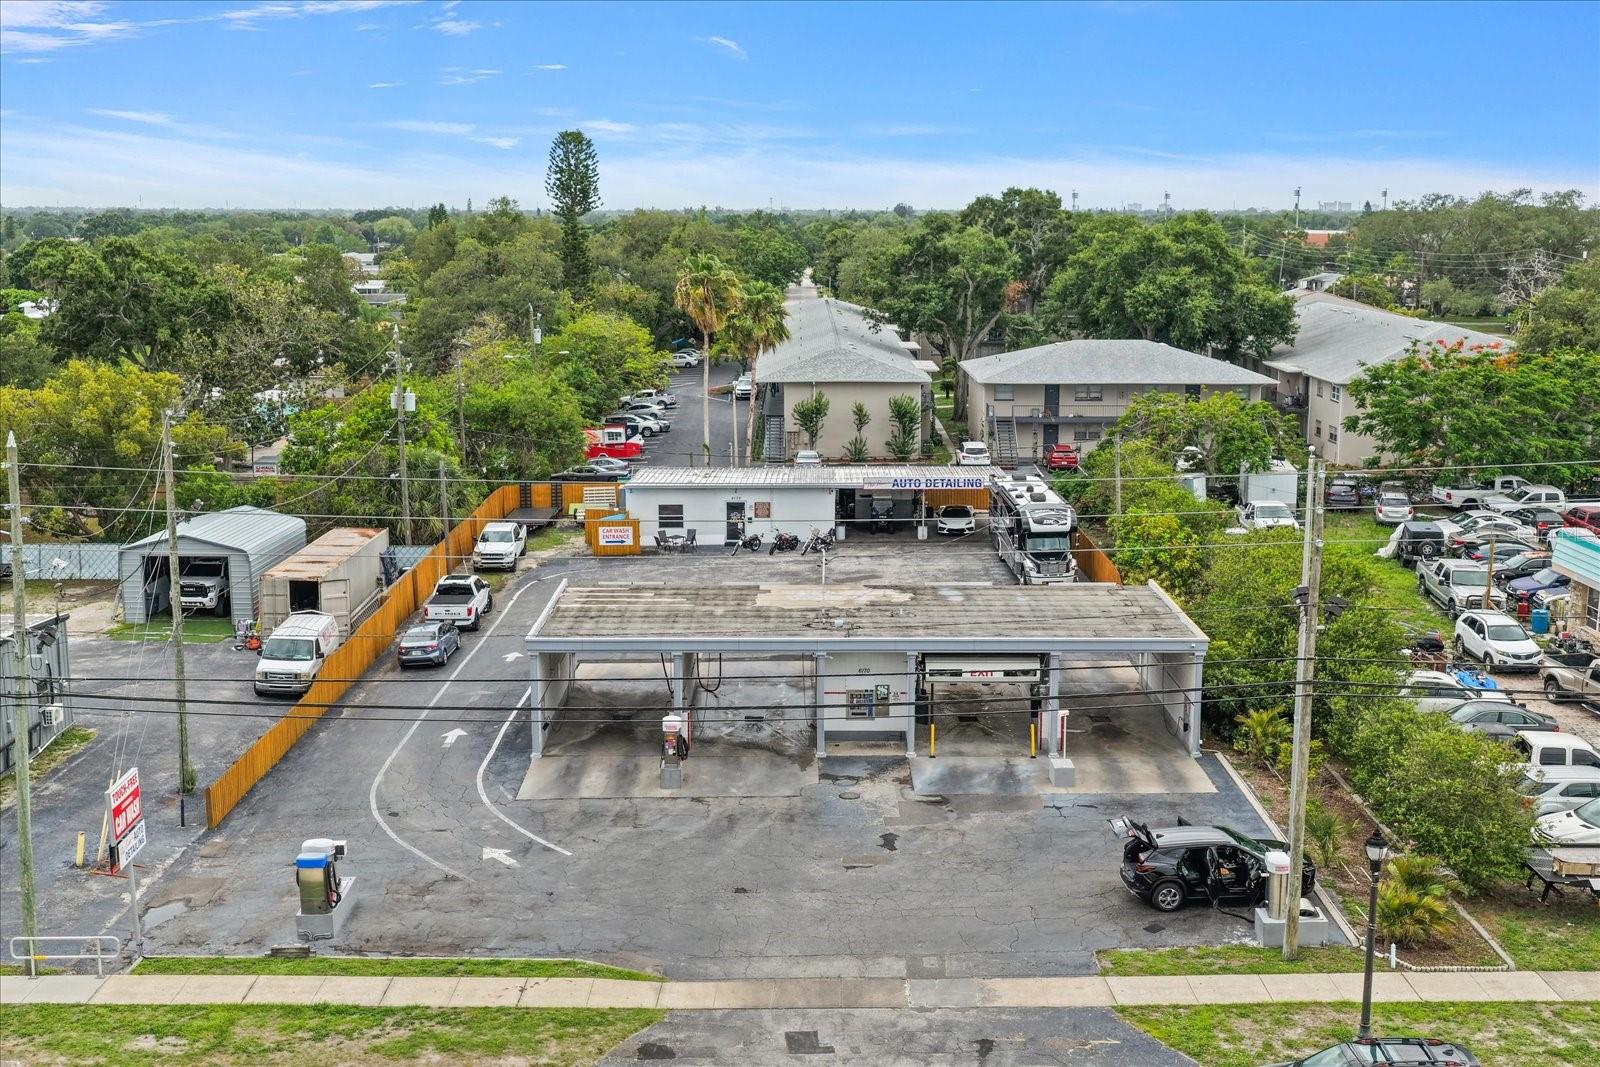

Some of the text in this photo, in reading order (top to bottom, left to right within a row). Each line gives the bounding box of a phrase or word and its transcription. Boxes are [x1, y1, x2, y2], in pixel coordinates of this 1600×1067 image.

[892, 478, 982, 488] AUTO DETAILING
[112, 774, 138, 804] TOUCH-FREE
